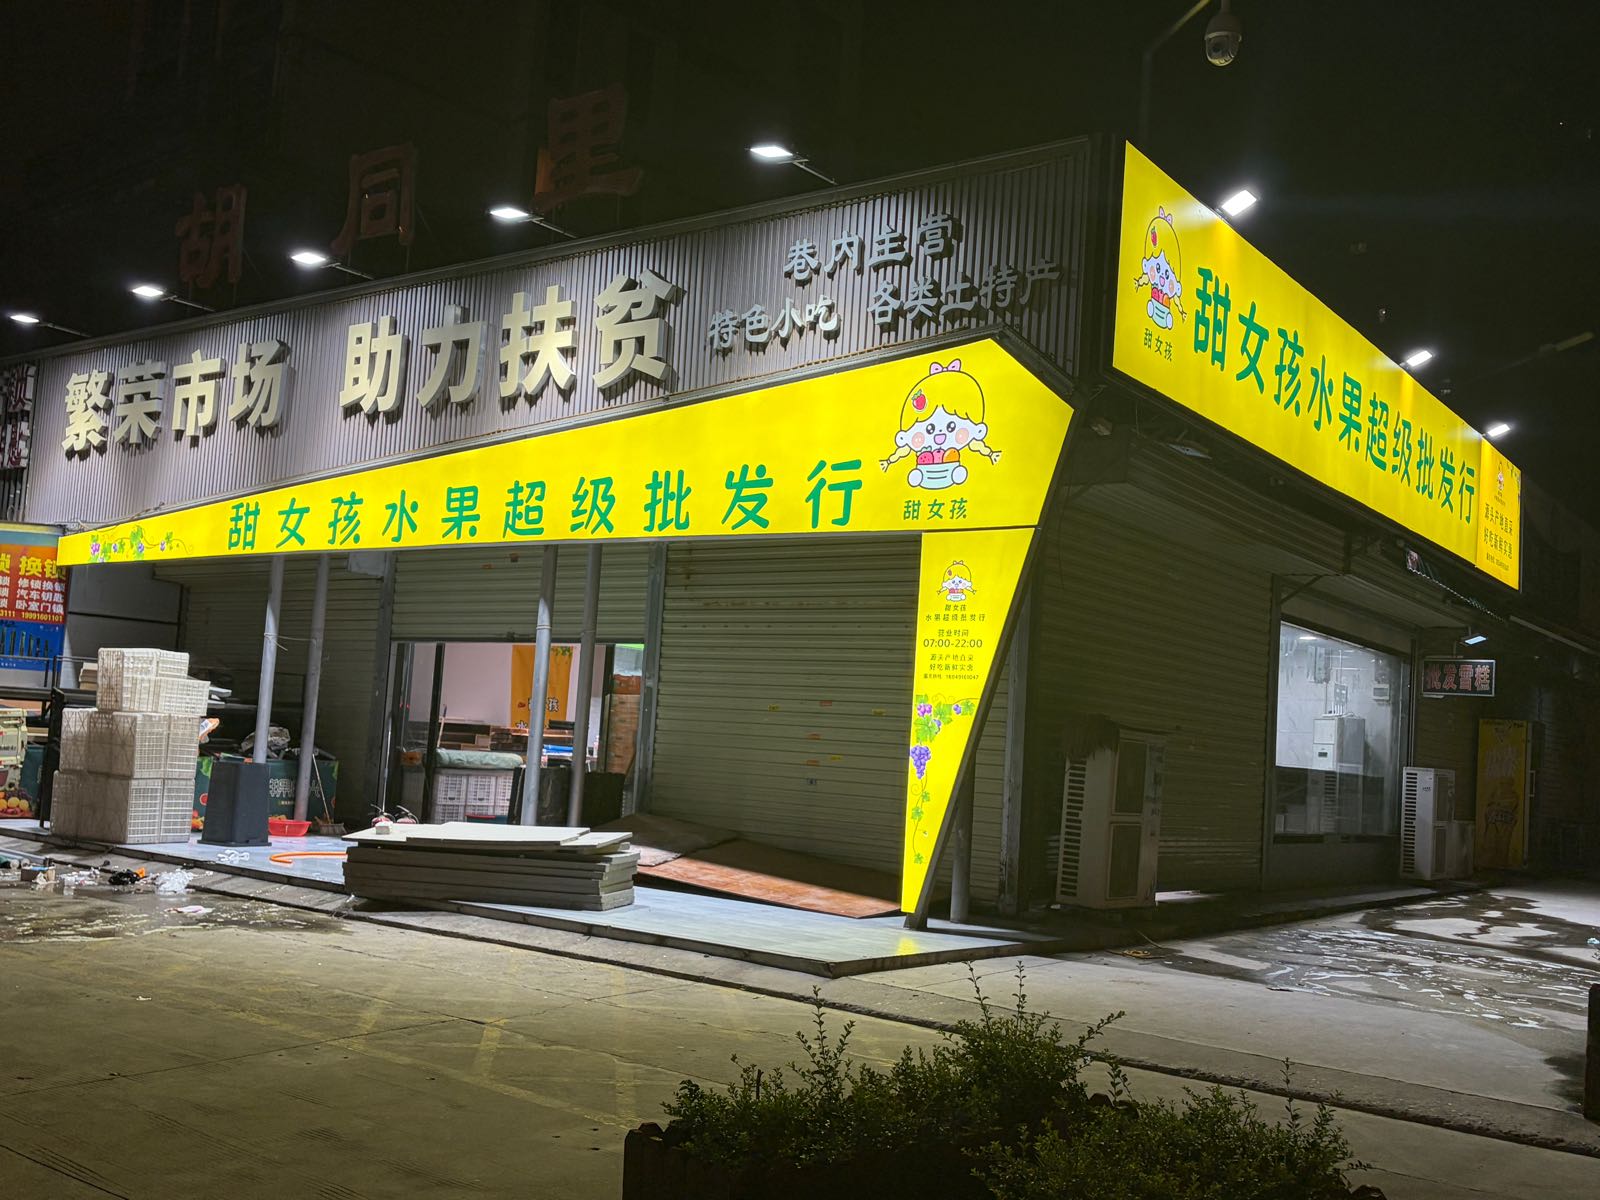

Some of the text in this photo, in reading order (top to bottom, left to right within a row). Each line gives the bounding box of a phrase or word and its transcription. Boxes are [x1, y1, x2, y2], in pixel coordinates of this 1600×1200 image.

[175, 83, 643, 288] 胡同里
[783, 212, 952, 281] 巷内主营
[708, 257, 1061, 350] 特色小吃 各类土特产
[1143, 327, 1173, 362] 甜女孩
[61, 339, 294, 452] 繁荣市场
[339, 268, 679, 413] 助力扶贫
[1193, 266, 1476, 525] 甜女孩水果超级批发行
[227, 458, 864, 551] 甜女孩水果超级批发行
[903, 497, 968, 520] 甜女孩
[15, 599, 64, 615] 卧室门锁
[16, 588, 64, 603] 汽车钥匙
[944, 604, 967, 612] 甜女孩
[925, 613, 986, 622] 水果超级批发行
[923, 638, 983, 649] 07:00-22:00
[938, 629, 969, 638] 营业时间
